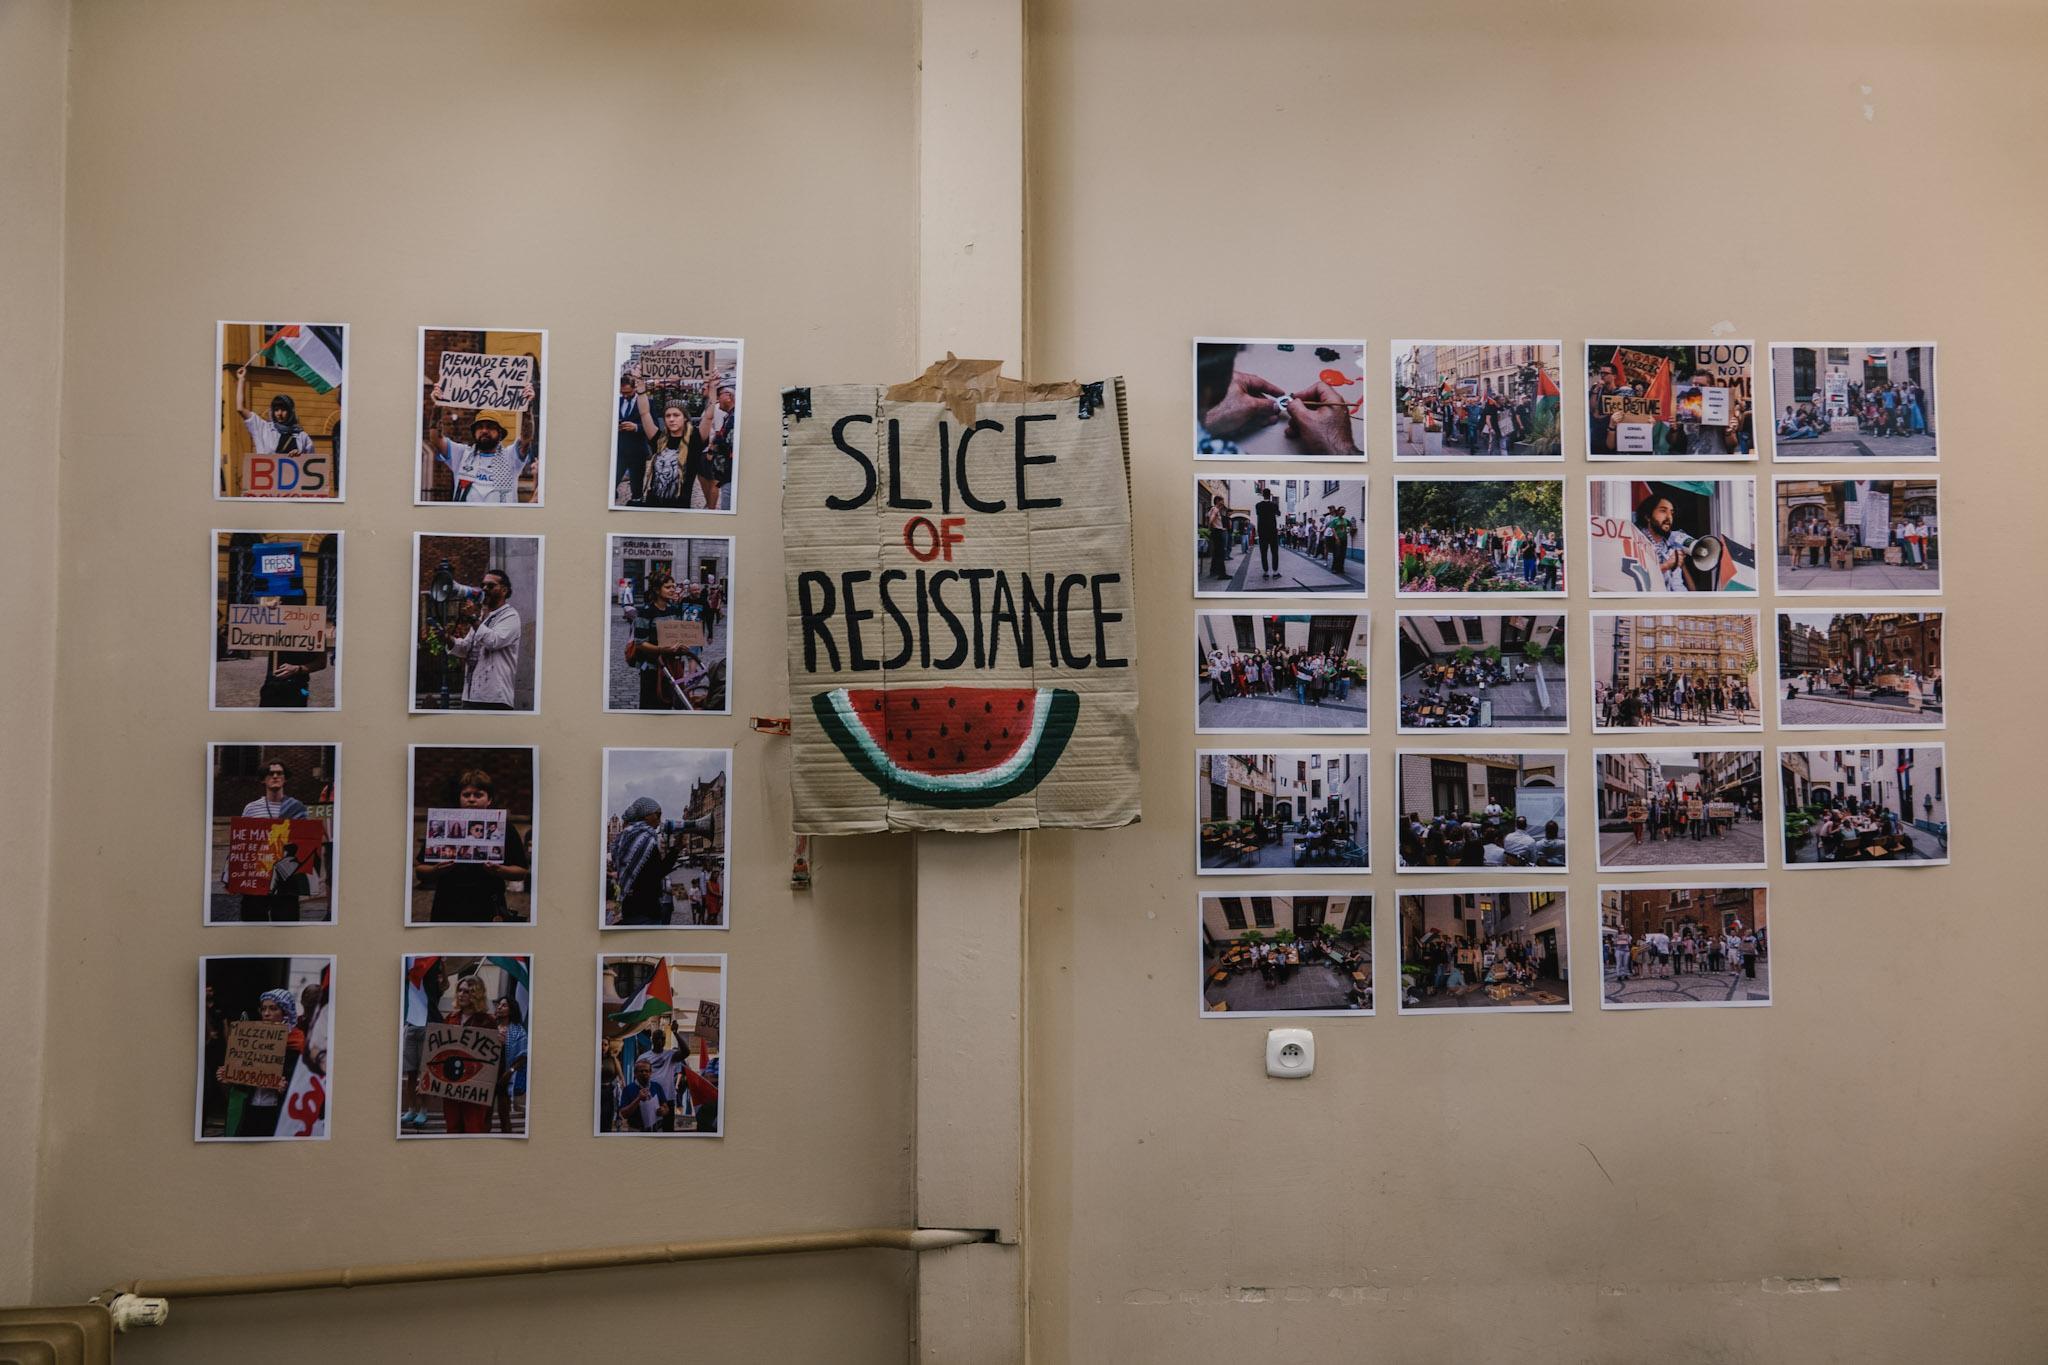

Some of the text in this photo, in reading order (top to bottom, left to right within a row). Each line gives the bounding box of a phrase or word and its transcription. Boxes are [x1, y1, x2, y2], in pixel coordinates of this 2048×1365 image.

[1698, 345, 1752, 365] BOO
[512, 357, 529, 368] NA
[498, 368, 527, 381] NIE
[1718, 366, 1744, 376] NOT
[472, 379, 498, 391] NA
[825, 413, 1062, 514] SLICE
[250, 458, 326, 490] BDS
[623, 541, 667, 551] KRUPA ART
[903, 516, 966, 563] OF
[623, 548, 673, 557] FOUNDATION
[264, 557, 293, 570] PRESS
[231, 606, 320, 630] IZRAEL zabija
[797, 568, 1129, 673] RESISTANCE
[233, 829, 271, 841] WE MAY
[240, 879, 257, 889] ARE
[428, 1029, 501, 1062] ALL EYES
[445, 1084, 488, 1102] RAFAH
